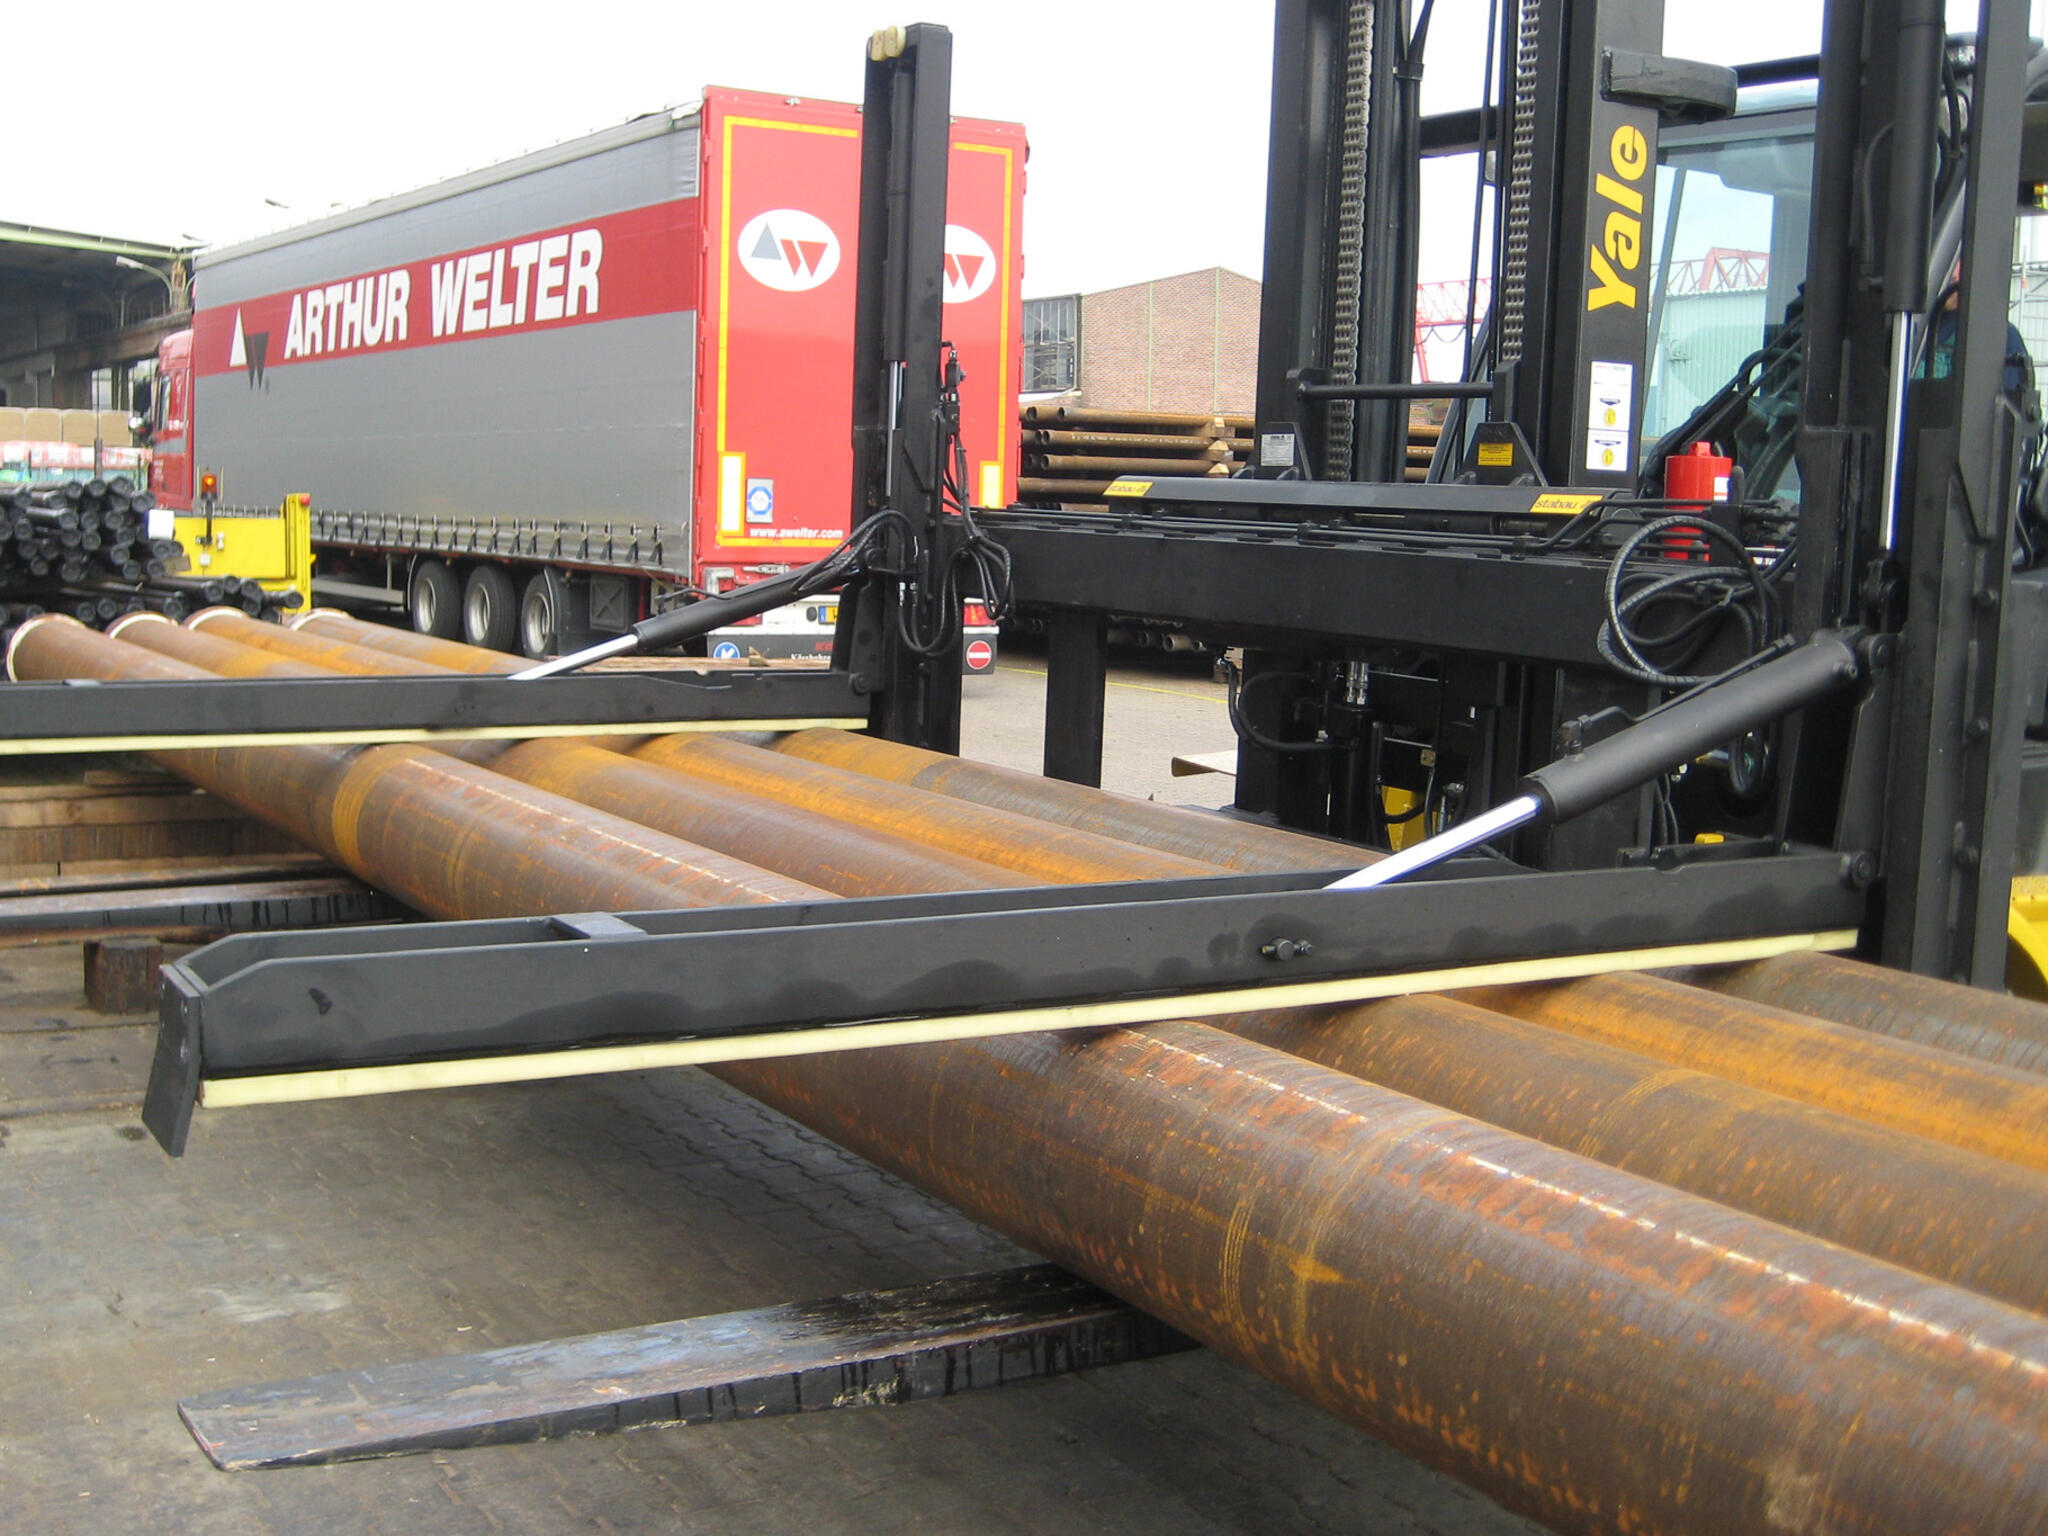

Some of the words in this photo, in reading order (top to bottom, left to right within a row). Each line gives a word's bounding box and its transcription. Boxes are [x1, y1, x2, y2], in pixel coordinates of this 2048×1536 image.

[1587, 125, 1648, 311] Yale
[284, 268, 411, 360] ARTHUR
[431, 228, 604, 338] WELTER
[749, 527, 843, 538] www.awelter.com
[1535, 498, 1578, 509] stabau
